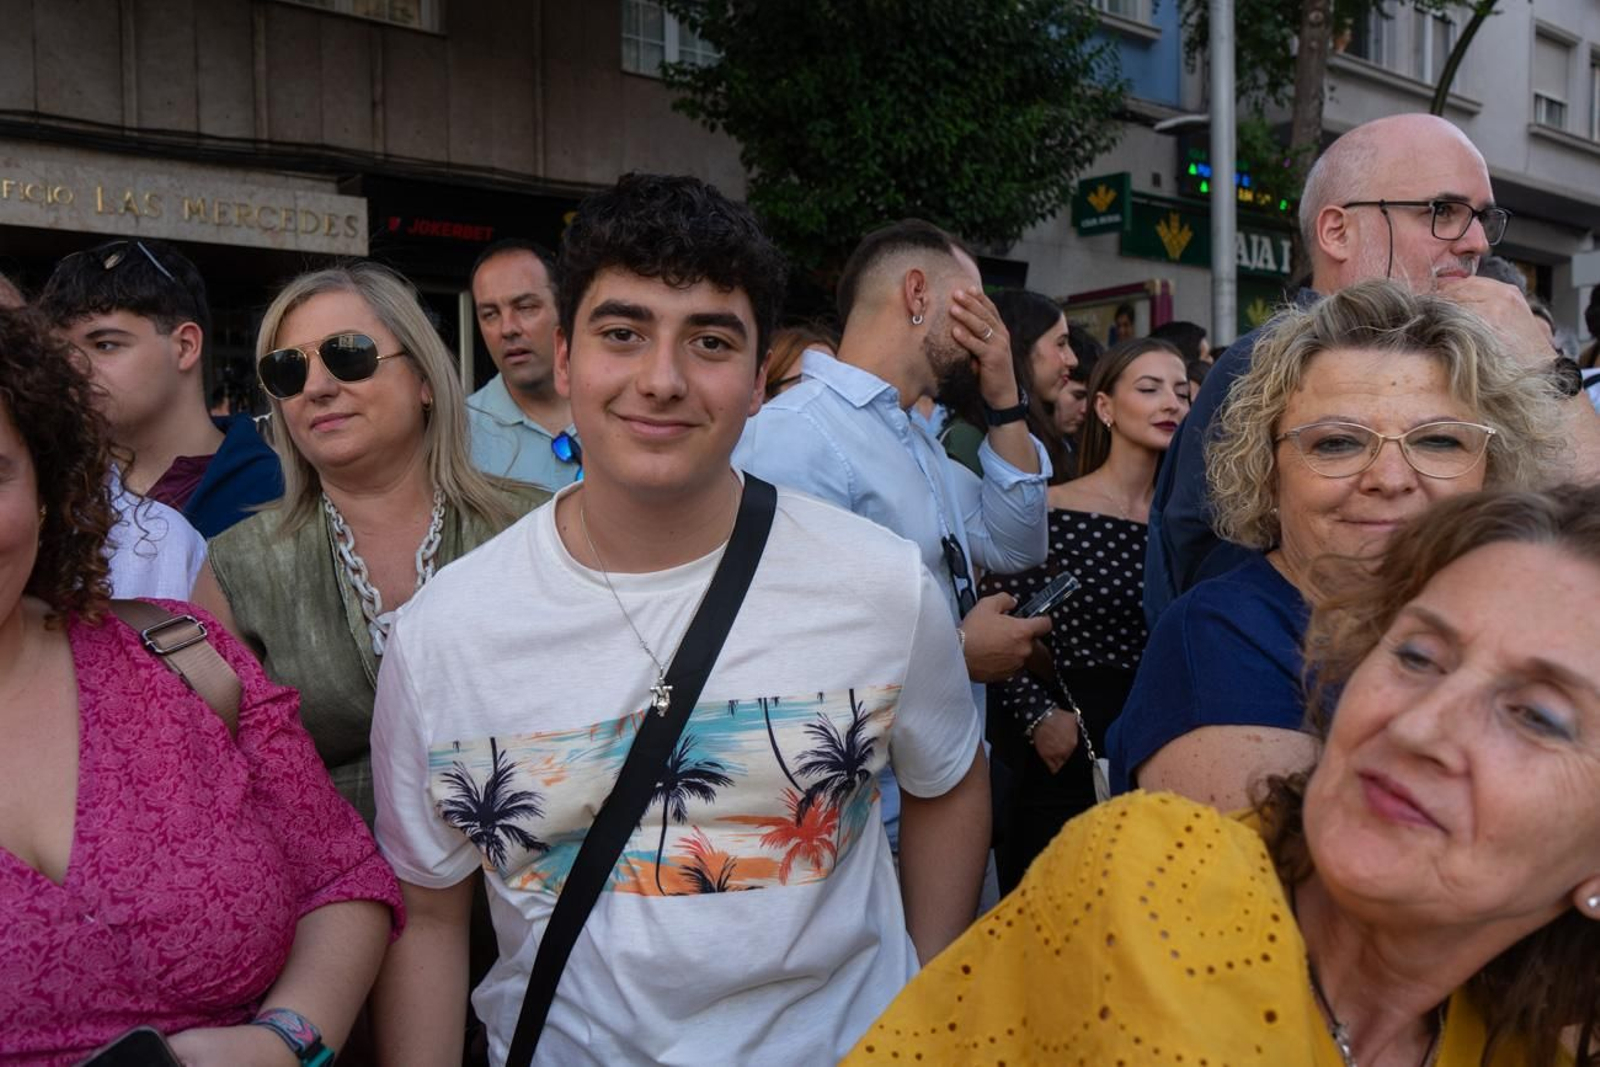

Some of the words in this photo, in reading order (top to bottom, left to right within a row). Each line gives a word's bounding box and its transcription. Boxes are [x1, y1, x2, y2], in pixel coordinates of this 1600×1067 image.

[95, 184, 162, 218] LAS
[182, 196, 359, 239] MERCEDES
[1235, 231, 1278, 271] AJA
